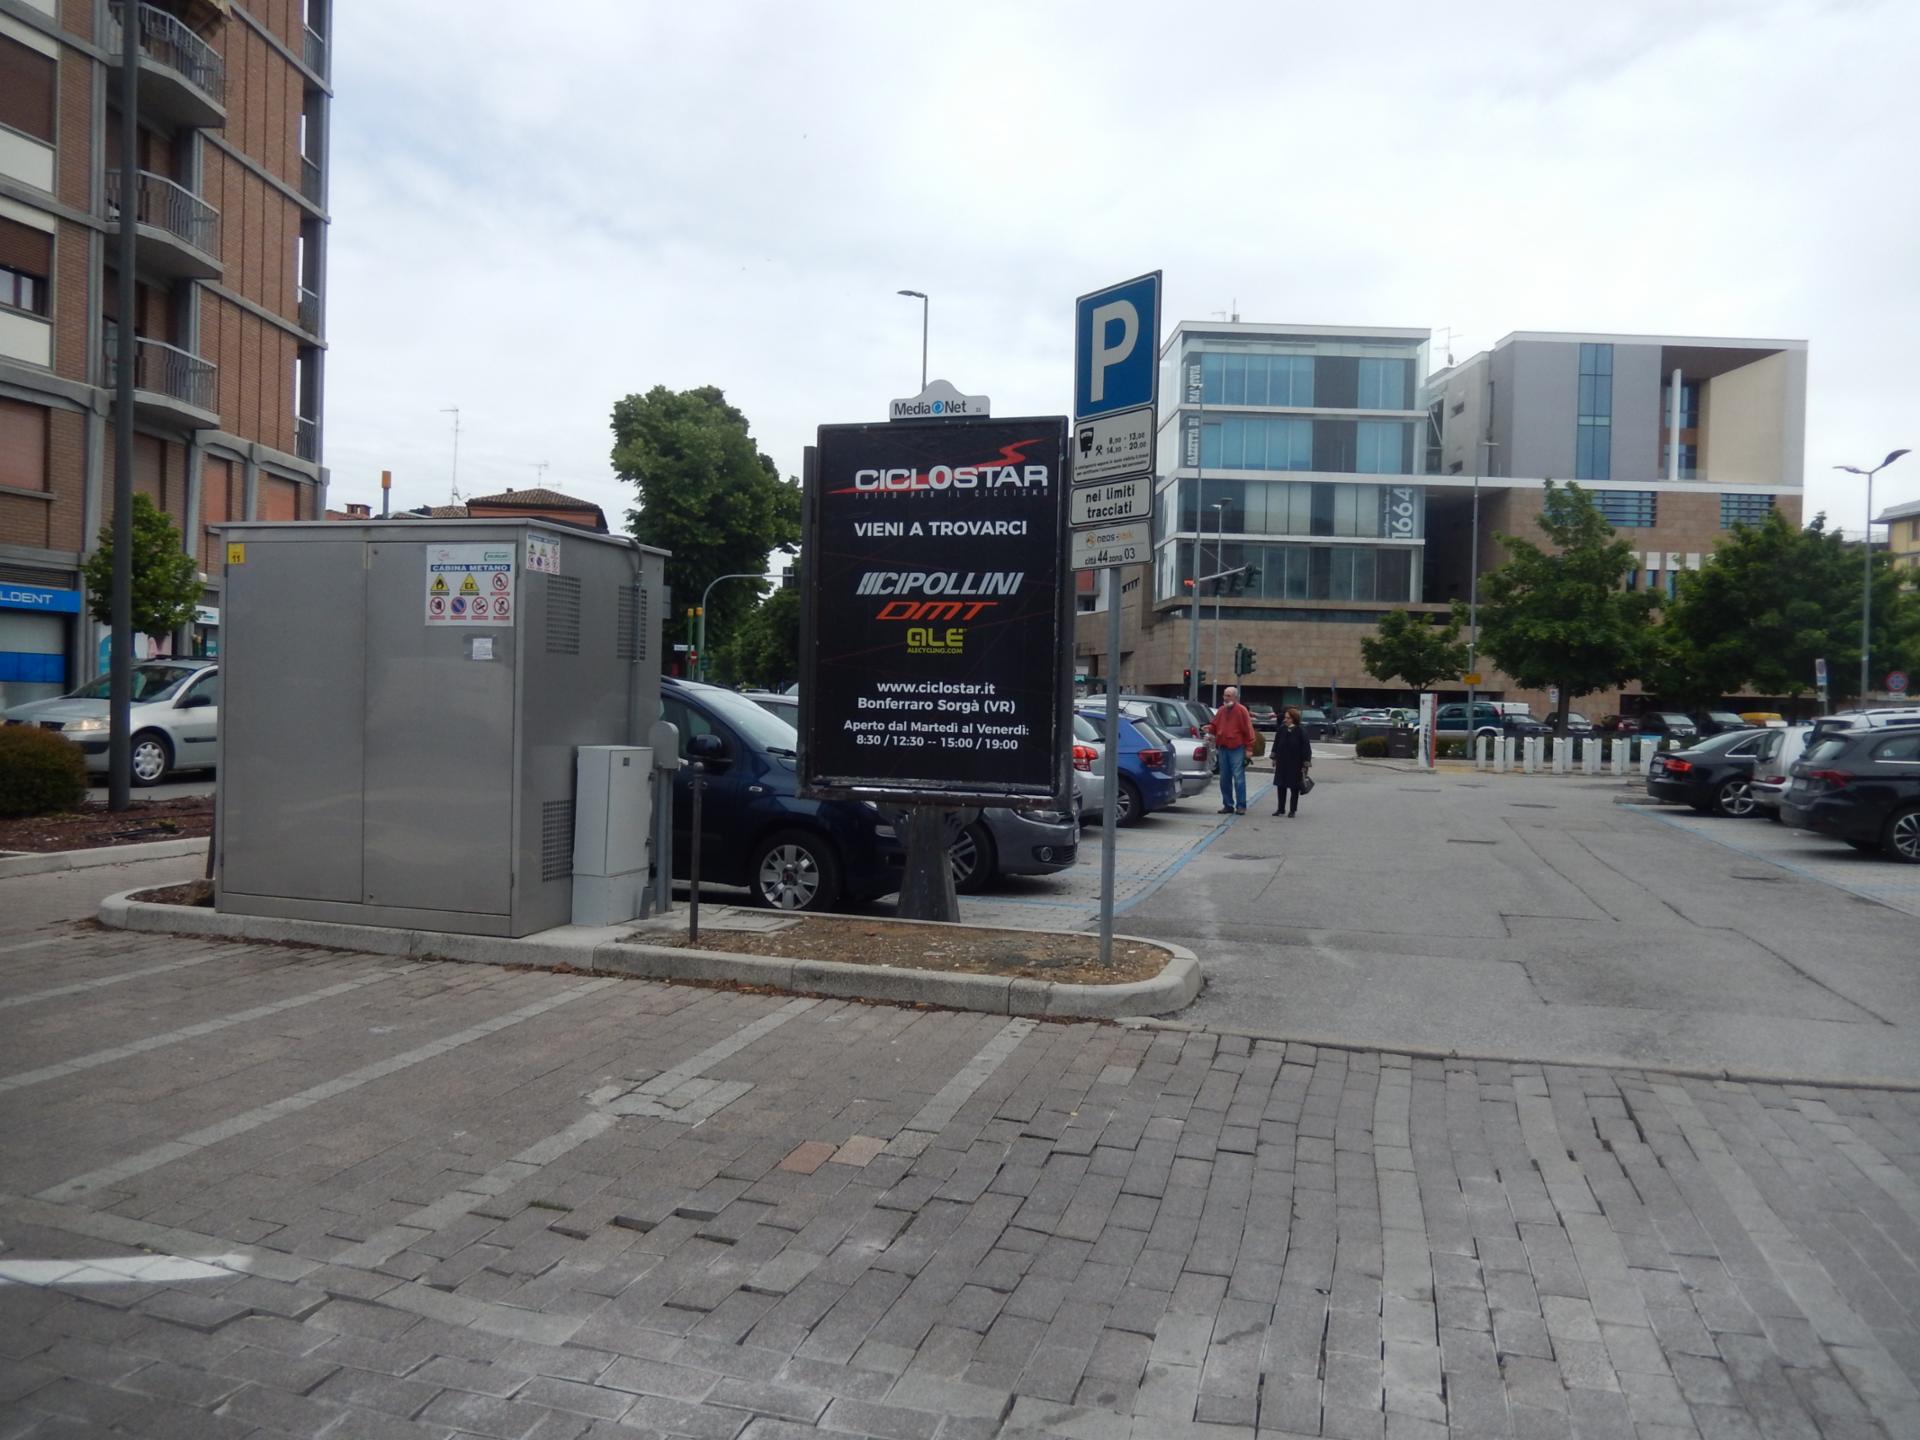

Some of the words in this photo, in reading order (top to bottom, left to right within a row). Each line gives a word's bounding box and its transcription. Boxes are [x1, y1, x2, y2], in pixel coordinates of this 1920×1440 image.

[1090, 299, 1140, 403] P
[894, 402, 931, 416] Media
[945, 400, 967, 413] Net
[855, 465, 1048, 490] CICLOSTAR
[1085, 489, 1101, 503] nei
[1106, 484, 1135, 500] limiti
[1087, 501, 1132, 518] tracciati
[1391, 487, 1413, 539] 1664
[854, 522, 904, 536] VIENI
[909, 521, 924, 536] A
[928, 520, 1027, 536] TROVARCI
[1097, 549, 1108, 564] 44
[1109, 554, 1123, 562] zona
[1124, 547, 1136, 560] 03
[877, 572, 1025, 595] CIPOLLINI
[875, 601, 999, 621] DMT
[876, 681, 996, 695] www.ciclostar.it
[857, 697, 934, 711] Bonferraro
[937, 699, 980, 714] Sorgà
[984, 700, 1016, 714] (VR)
[843, 719, 885, 732] Aperto
[888, 720, 907, 732] dal
[910, 721, 958, 733] Martedì
[961, 722, 973, 734] al
[976, 723, 1030, 735] Venerdì:
[856, 734, 881, 745] 8:30
[892, 735, 924, 747] 12:30
[940, 737, 973, 749] 15:00
[985, 738, 1019, 750] 19:00
